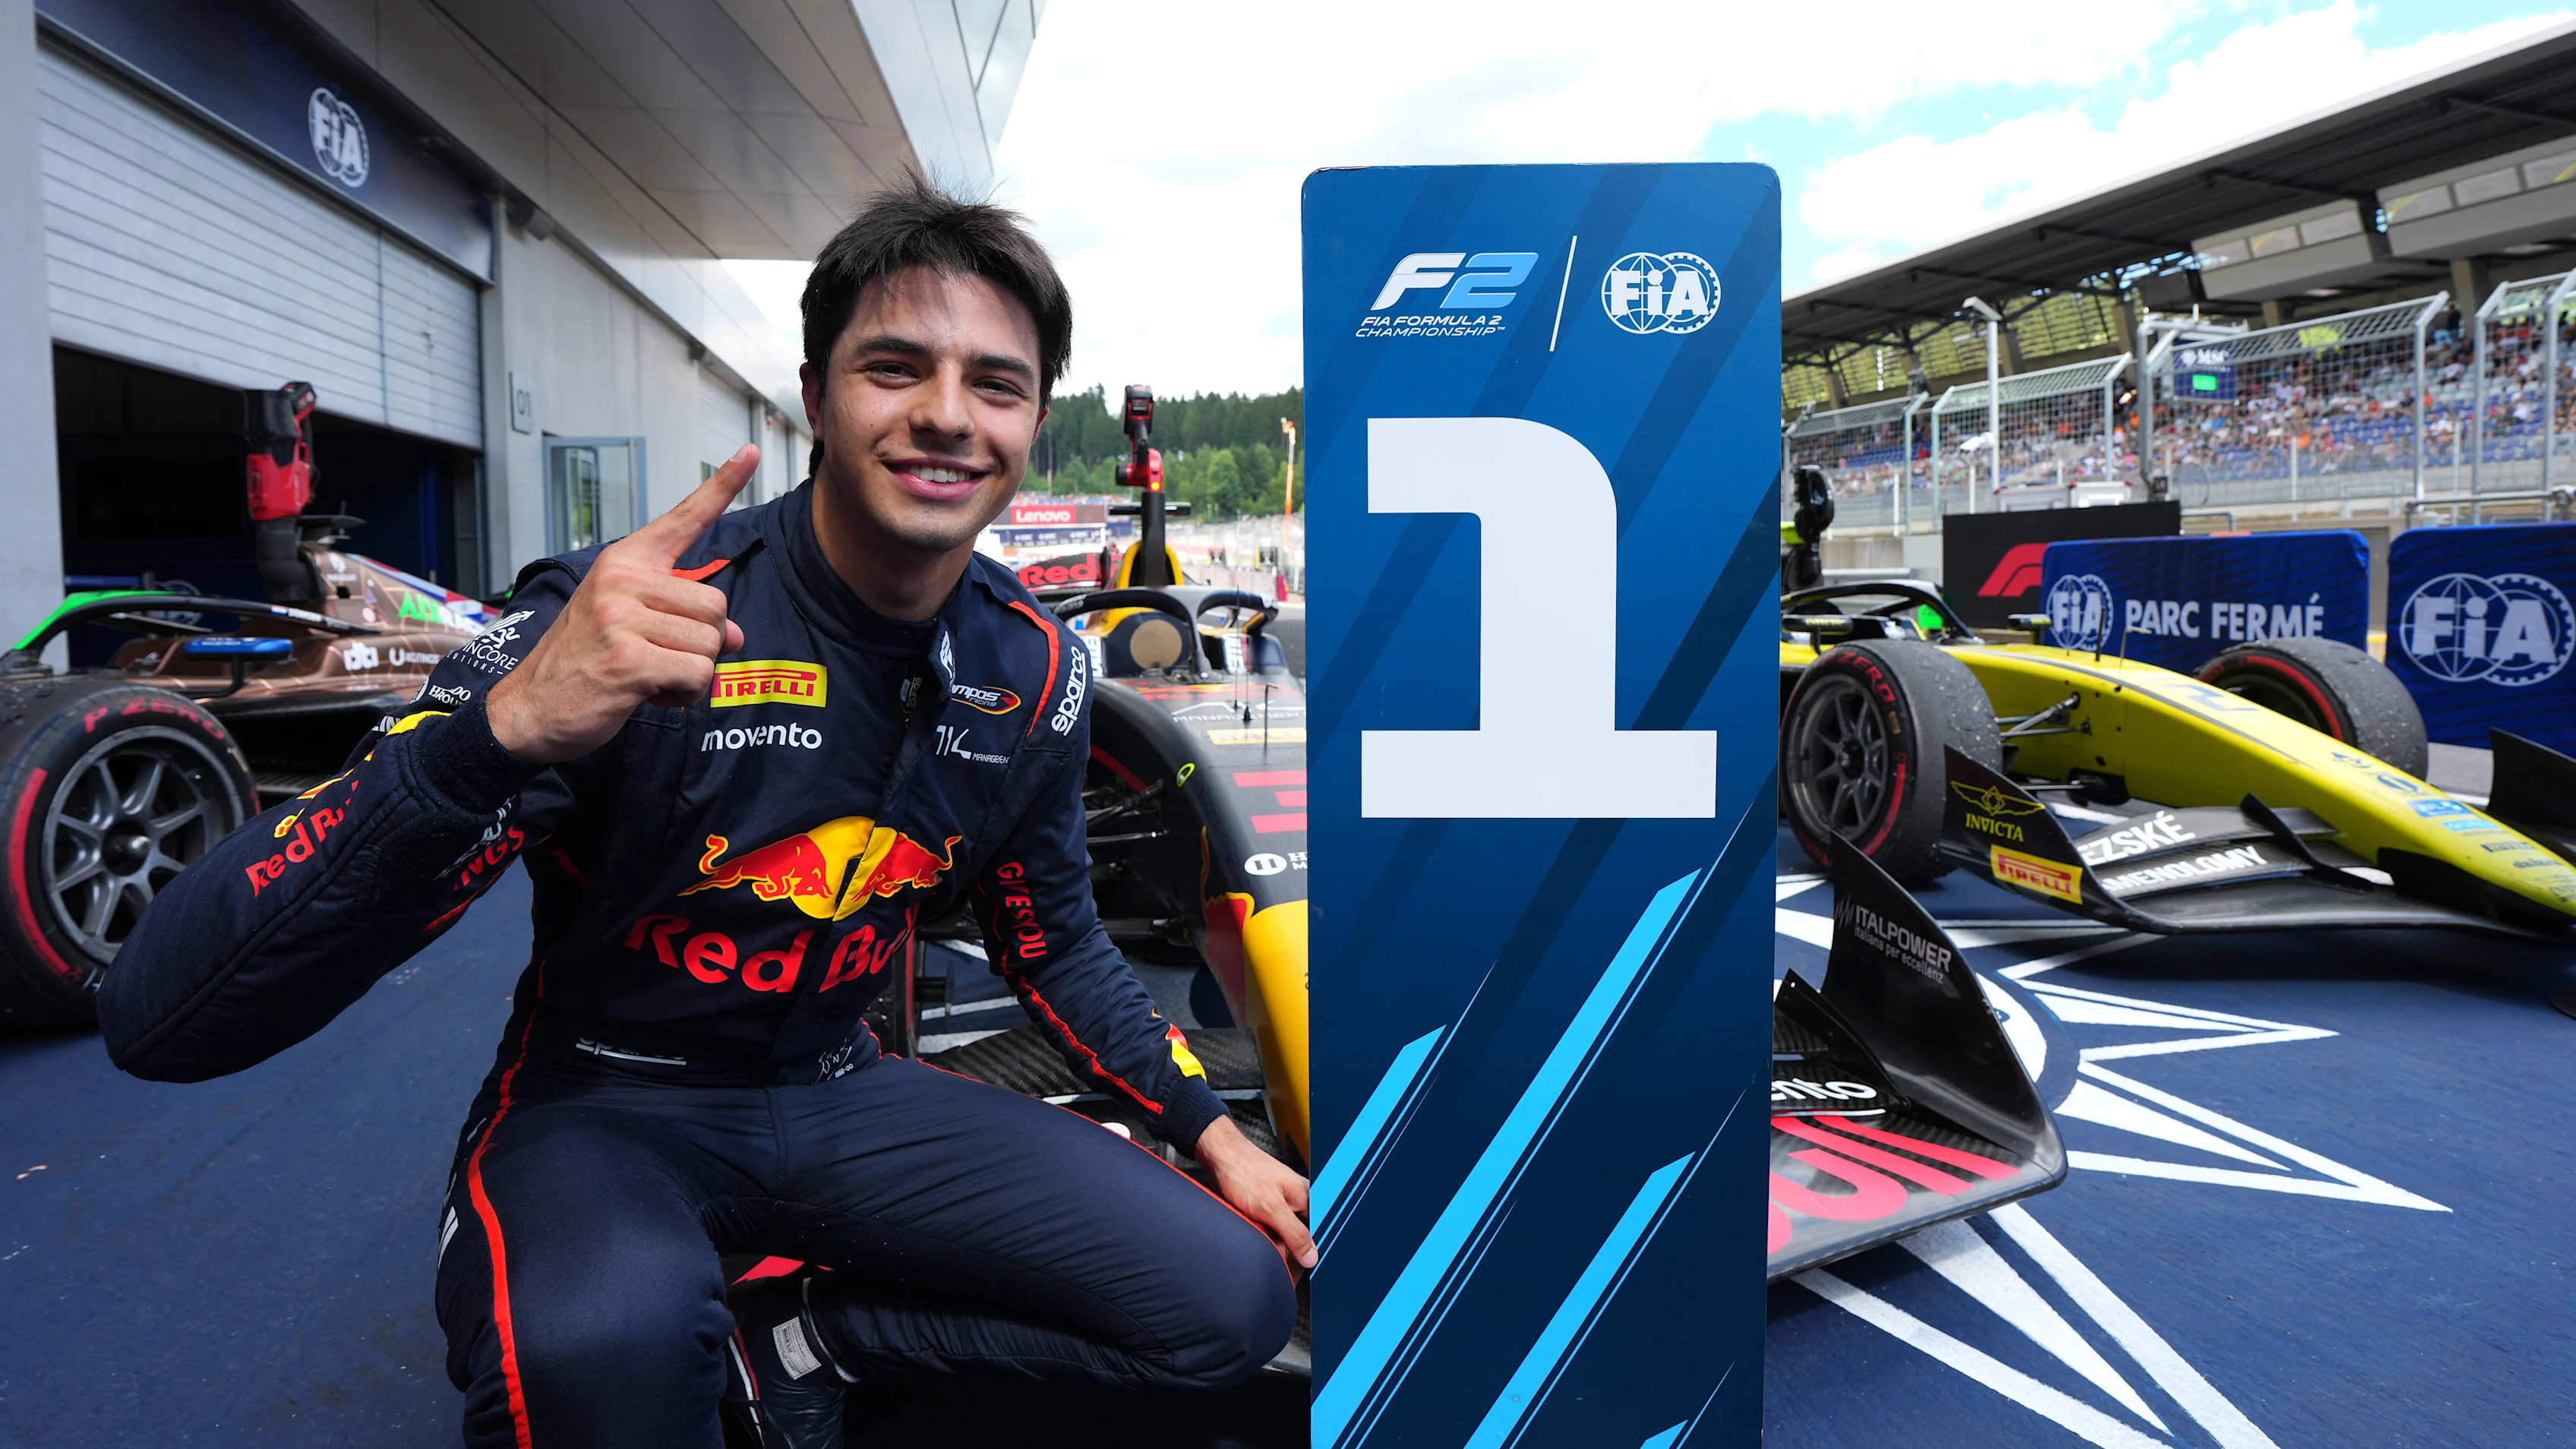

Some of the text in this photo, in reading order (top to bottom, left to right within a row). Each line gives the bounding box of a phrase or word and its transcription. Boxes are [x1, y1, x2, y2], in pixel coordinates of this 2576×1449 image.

[1370, 252, 1539, 311] F2
[1361, 315, 1503, 327] FIA FORMULA 2
[516, 389, 532, 416] 01
[1015, 508, 1072, 524] Lenovo
[1018, 553, 1098, 588] Red
[1361, 417, 1718, 818] 1
[2126, 592, 2325, 642] PARC FERMÉ
[711, 668, 818, 698] PIRELLI
[1051, 646, 1087, 737] sparco
[1838, 651, 1896, 703] ZERO
[84, 706, 109, 734] P
[968, 696, 998, 708] racing
[701, 721, 822, 753] movento
[1965, 813, 2025, 842] INVICTA
[245, 821, 315, 898] Red
[1998, 854, 2072, 895] PIRELLI
[623, 913, 816, 993] Red
[1012, 915, 1047, 958] YOU
[1855, 904, 1952, 973] ITALPOWER
[1855, 923, 1884, 951] italiana
[1885, 943, 1900, 959] per
